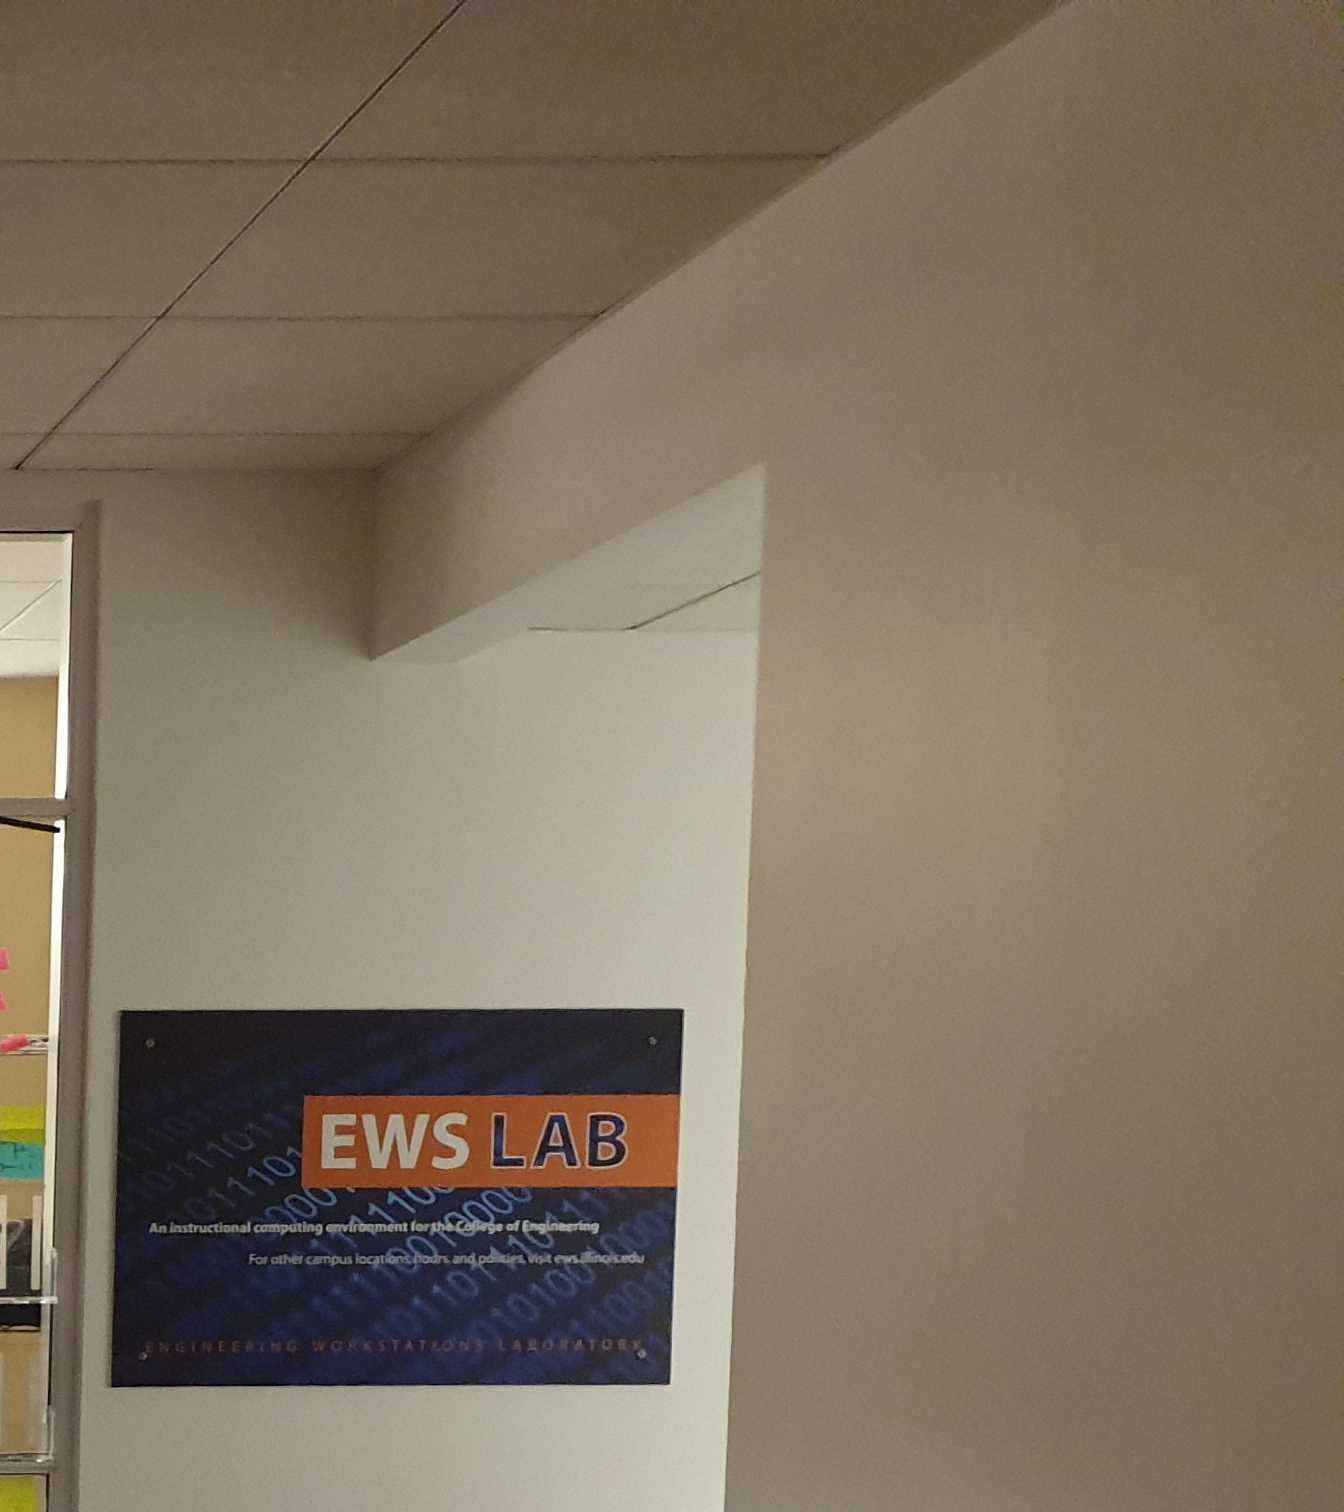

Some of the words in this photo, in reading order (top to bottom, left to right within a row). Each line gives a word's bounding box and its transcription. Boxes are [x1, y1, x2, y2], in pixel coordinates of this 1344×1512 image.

[321, 1112, 470, 1169] EWS
[490, 1111, 628, 1169] LAB
[149, 1222, 167, 1234] An
[170, 1221, 251, 1234] instructional
[254, 1222, 323, 1236] computing
[326, 1221, 408, 1234] environment
[411, 1220, 430, 1232] for
[431, 1220, 454, 1232] the
[456, 1220, 503, 1234] College
[506, 1220, 520, 1232] of
[522, 1220, 600, 1234] Engineering
[249, 1254, 267, 1265] For
[271, 1254, 303, 1265] other
[306, 1255, 353, 1266] campus
[453, 1253, 476, 1265] and
[144, 1341, 298, 1353] ENGINEERING
